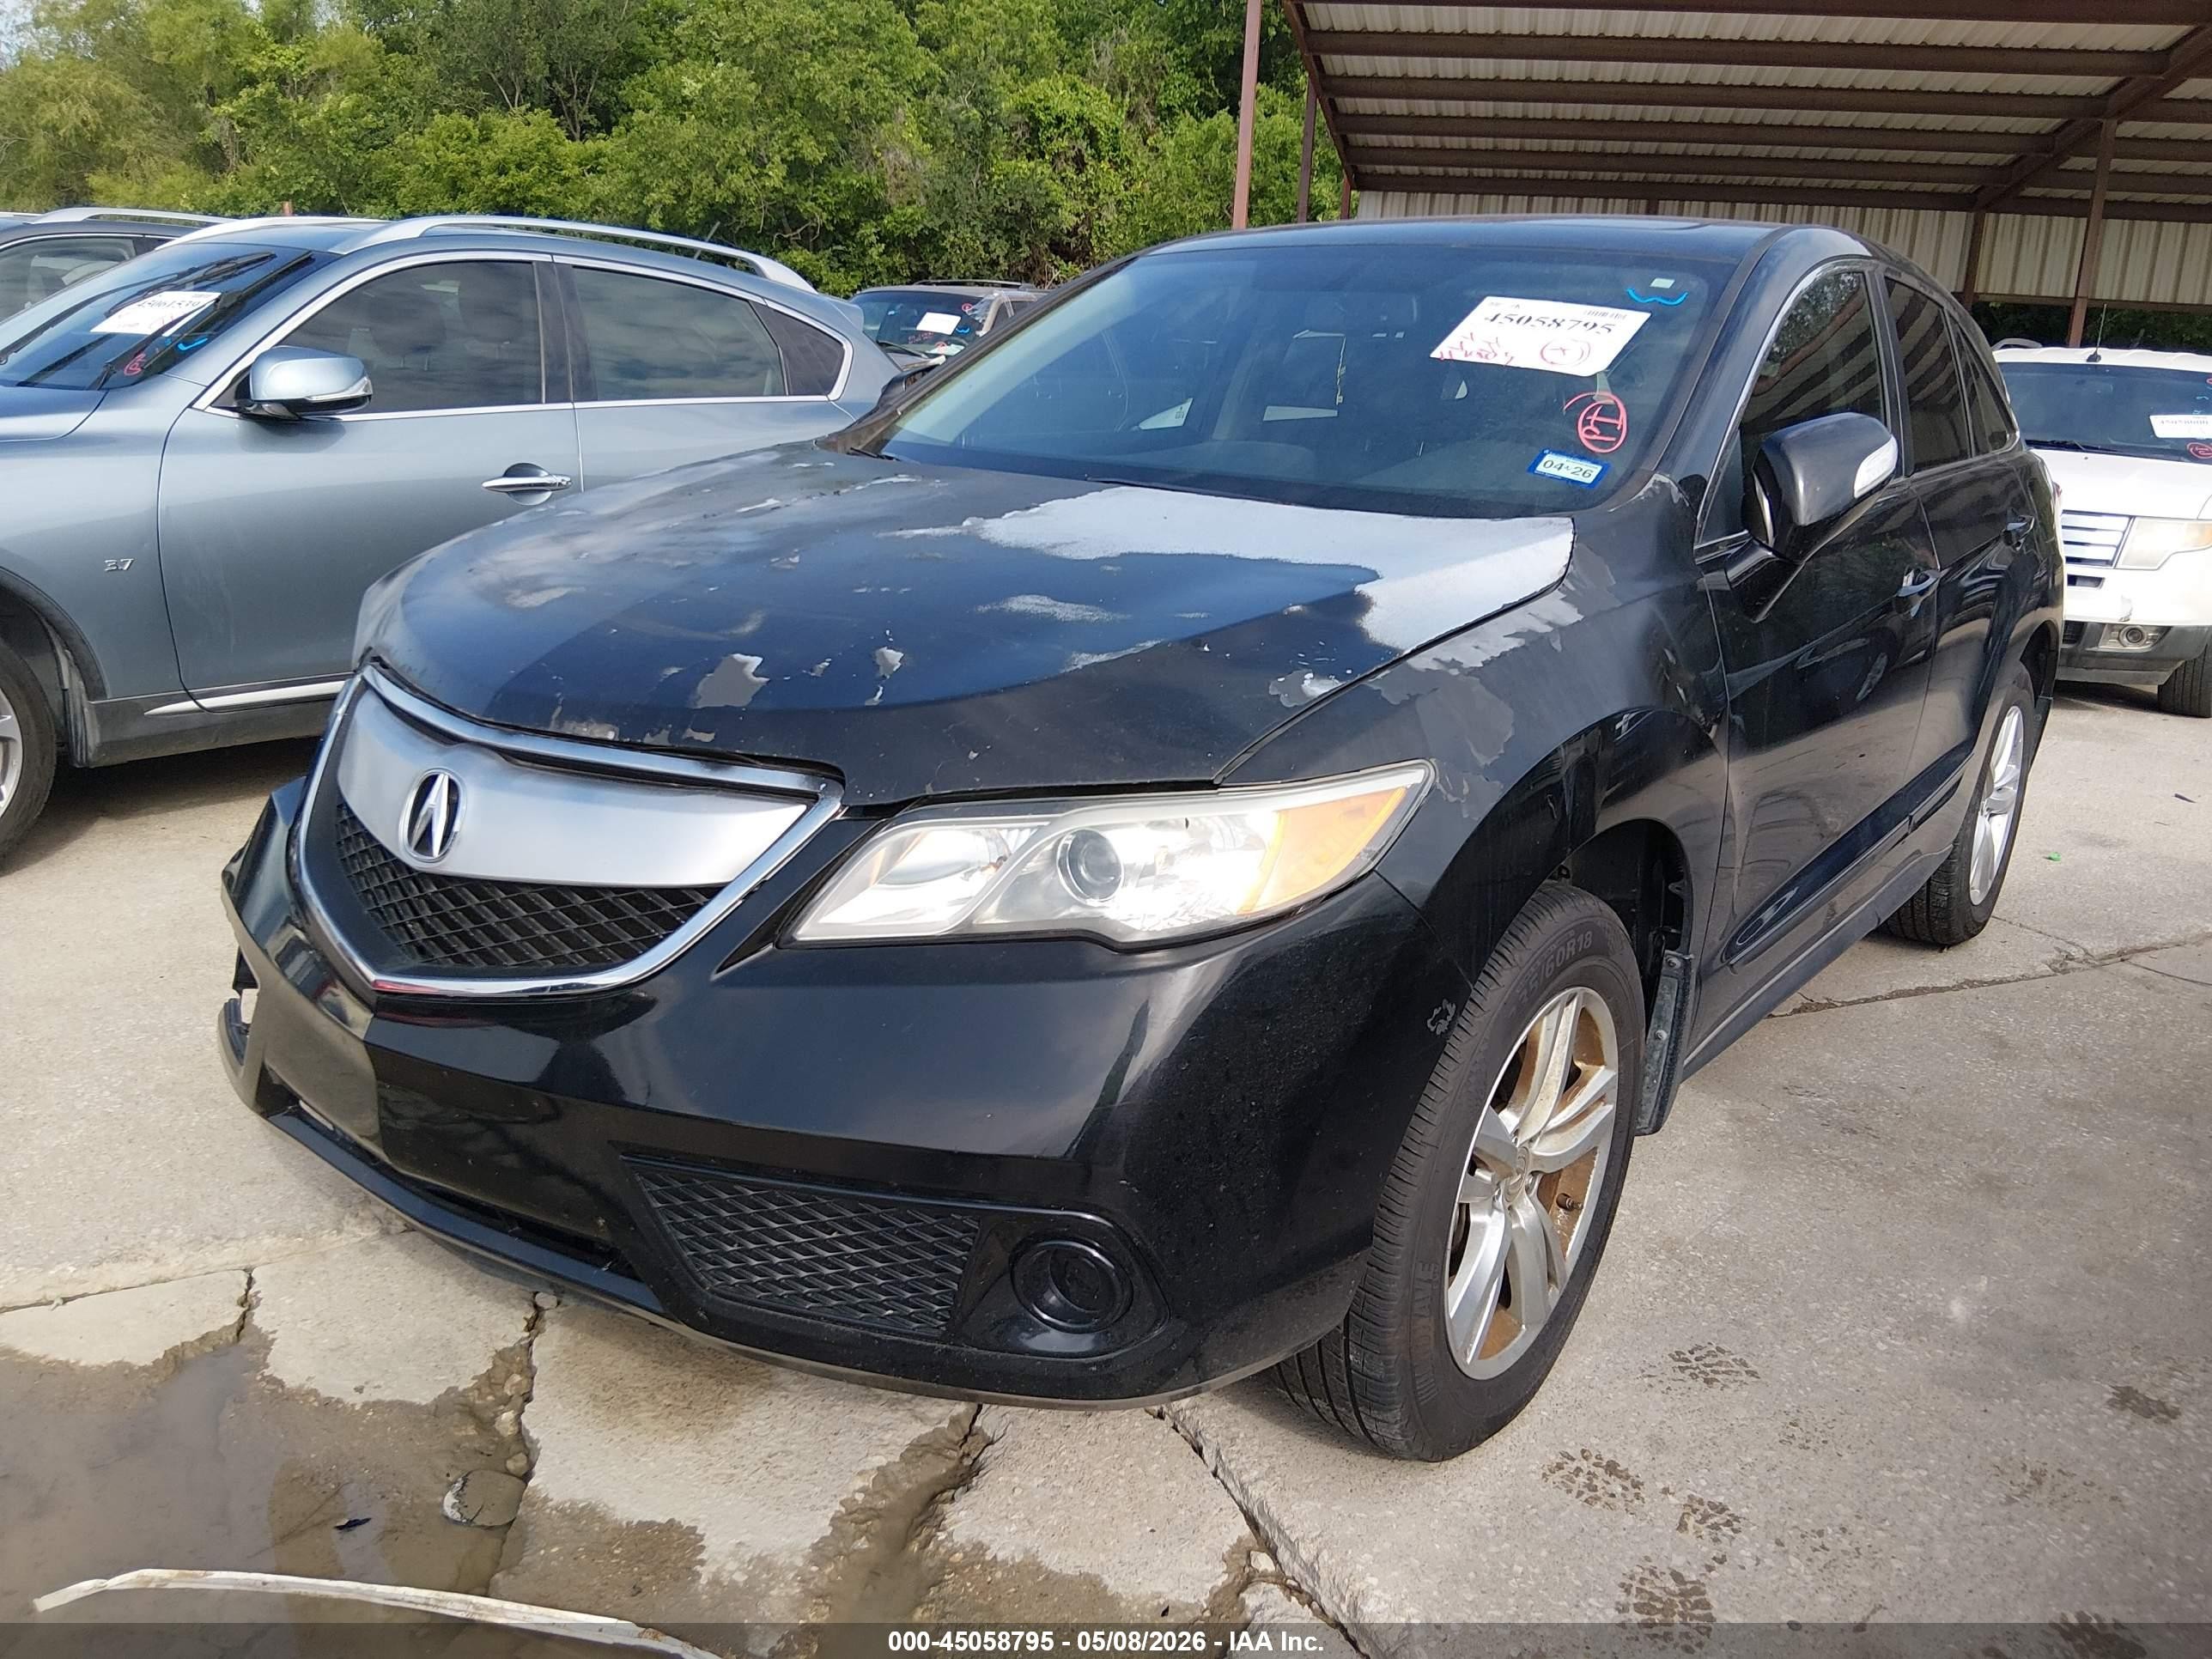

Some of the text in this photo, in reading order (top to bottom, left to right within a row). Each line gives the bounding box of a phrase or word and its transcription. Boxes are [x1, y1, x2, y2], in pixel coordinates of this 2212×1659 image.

[1484, 313, 1616, 334] 45058795
[104, 558, 134, 571] 3.7
[1509, 930, 1592, 1017] 35/60R18
